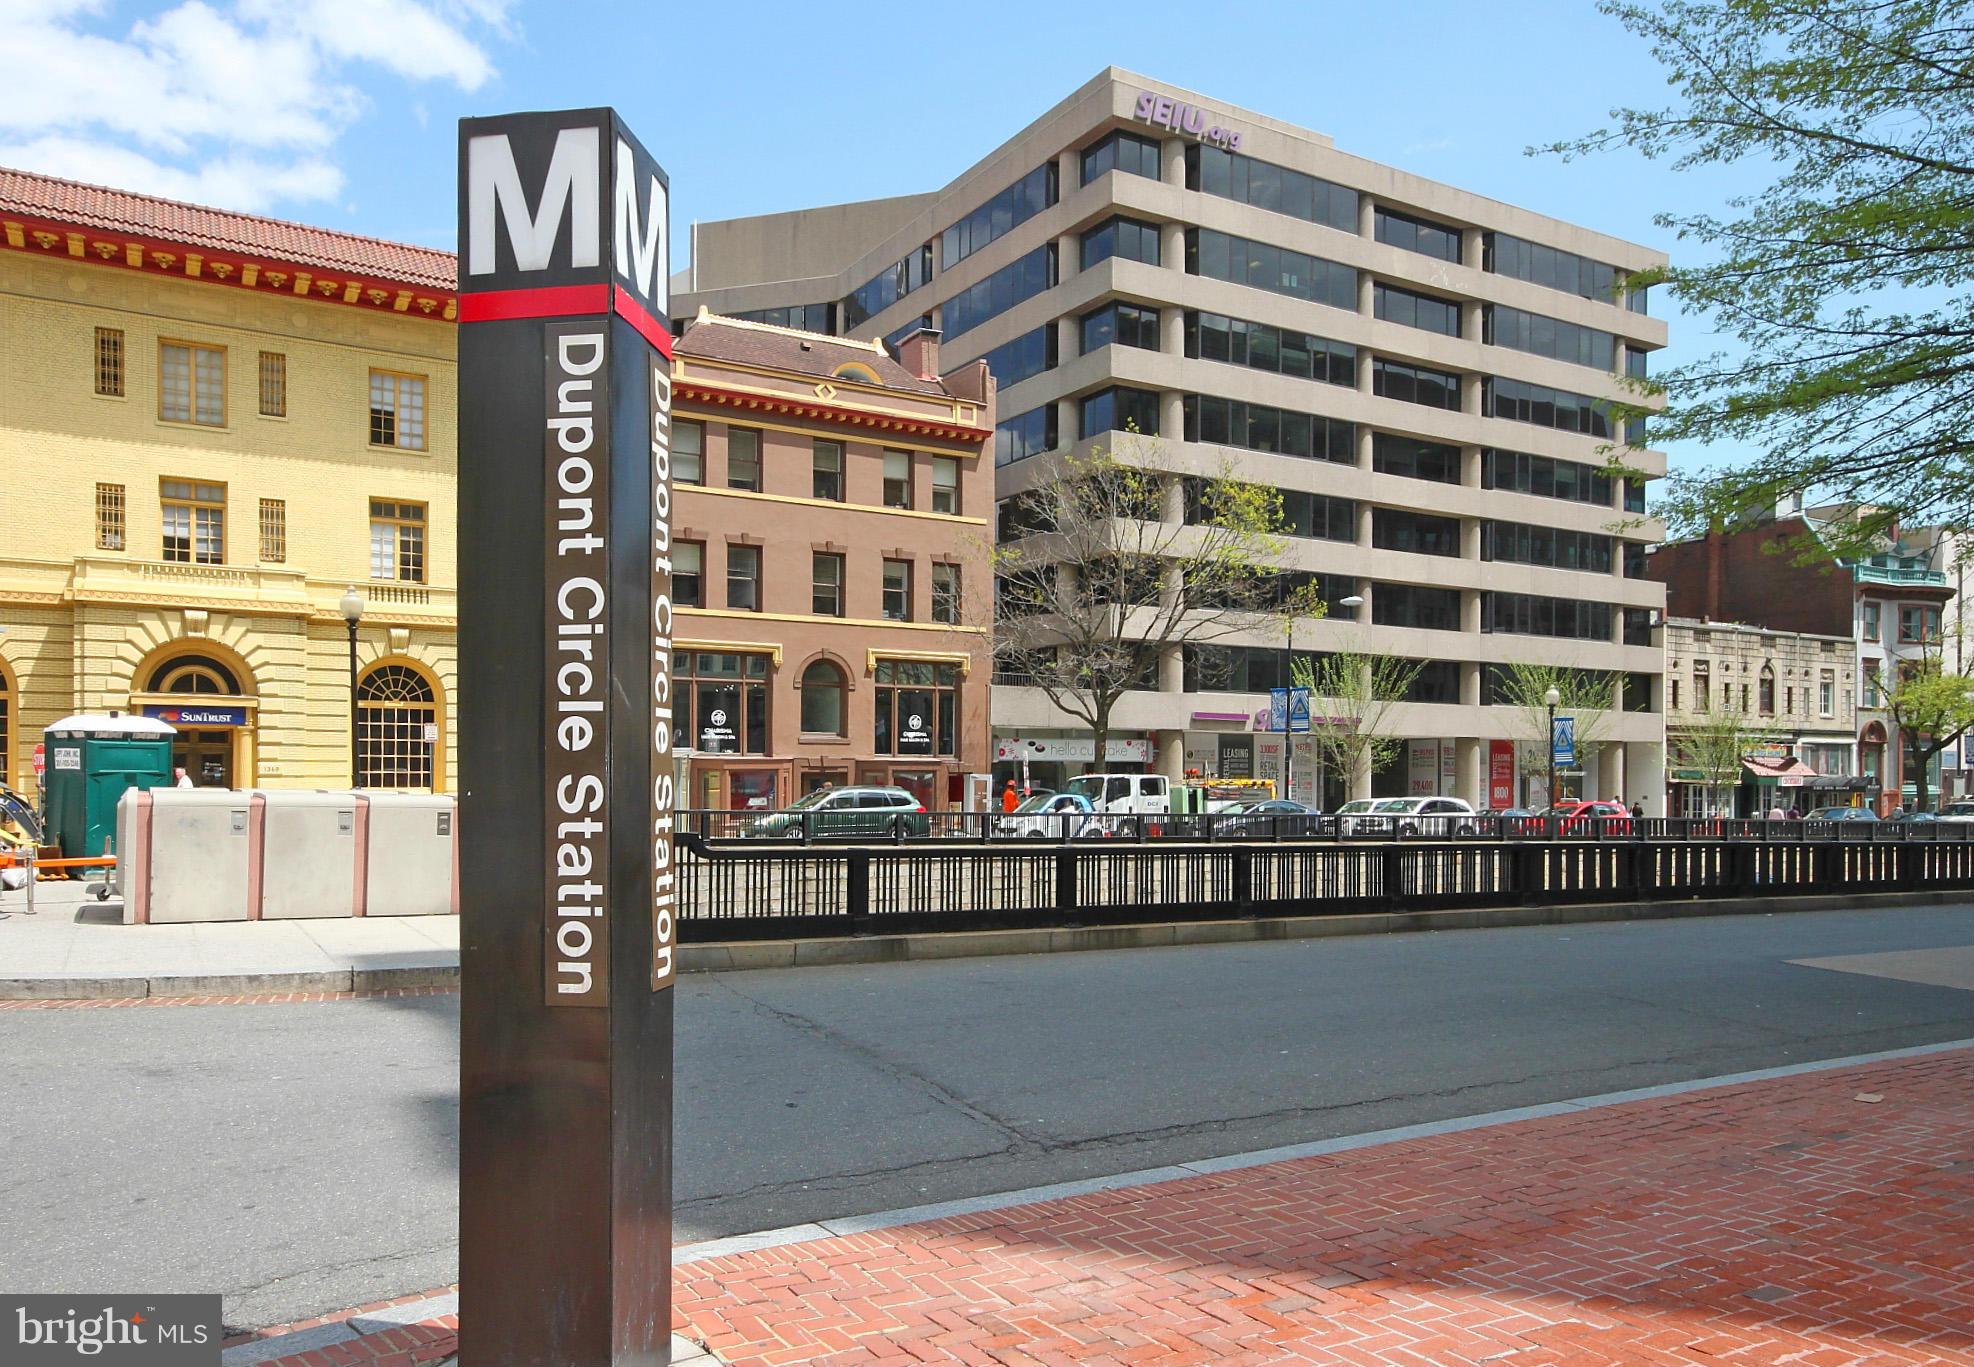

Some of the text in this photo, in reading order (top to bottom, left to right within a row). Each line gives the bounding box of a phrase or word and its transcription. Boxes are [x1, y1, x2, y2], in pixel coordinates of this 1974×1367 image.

[1136, 92, 1242, 151] SEIU.org
[469, 126, 600, 276] M
[615, 135, 668, 318] M
[547, 333, 606, 994] Dupont Circle Station
[651, 367, 674, 979] Dupont Circle Station
[1050, 743, 1129, 757] hello cuake
[1223, 748, 1249, 759] LEASING
